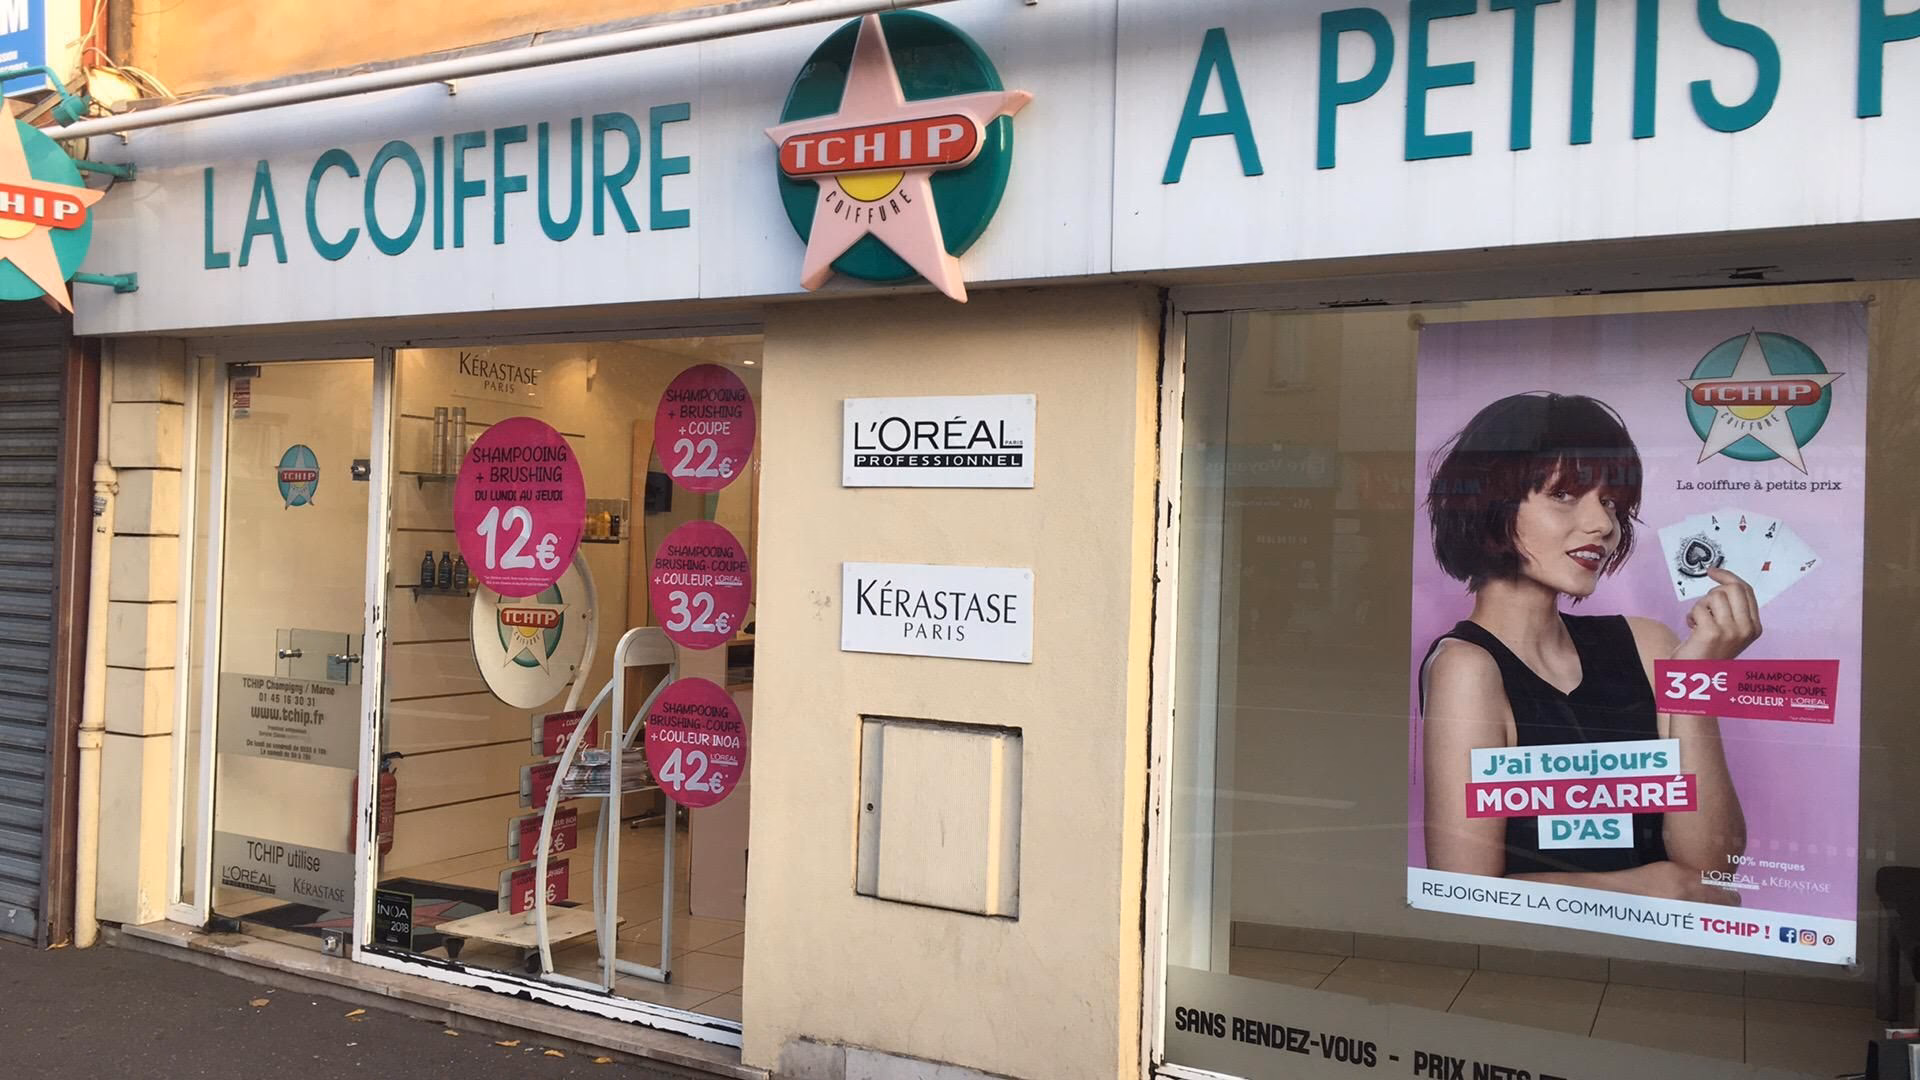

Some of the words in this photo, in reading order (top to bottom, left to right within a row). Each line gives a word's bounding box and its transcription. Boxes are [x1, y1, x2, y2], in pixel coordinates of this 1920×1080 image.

[1162, 27, 1263, 184] A
[788, 123, 964, 169] TCHIP
[204, 160, 288, 269] LA
[305, 102, 690, 262] COIFFURE
[825, 188, 912, 224] COIFFURE
[460, 351, 538, 386] KÉRASTASE
[484, 380, 515, 393] PARIS
[666, 389, 745, 402] SHAMPOOING
[1699, 384, 1812, 401] TCHIP
[680, 405, 742, 418] BRUSHING
[1721, 412, 1780, 430] COIFFURE
[854, 416, 1023, 452] L'ORÉAL
[472, 445, 567, 463] SHAMPOOING
[856, 455, 1021, 467] PROFESSIONNEL
[283, 472, 316, 481] TCHIP
[489, 466, 563, 483] BRUSHING
[1676, 480, 1694, 490] La
[1697, 480, 1750, 490] coiffure
[1754, 480, 1763, 490] à
[1766, 480, 1807, 492] petits
[1811, 480, 1842, 492] prix
[475, 490, 488, 501] DU
[490, 490, 517, 501] LUNDI
[519, 490, 533, 501] AU
[535, 490, 563, 501] JEUDI
[667, 545, 734, 558] SHAMPOOING
[857, 579, 1017, 624] KÉRASTASE
[503, 609, 557, 625] TCHIP
[904, 622, 965, 641] PARIS
[243, 677, 264, 689] TCHIP
[266, 679, 304, 695] Champigny
[311, 684, 335, 696] Marne
[1665, 671, 1728, 701] 32€
[1745, 671, 1821, 684] SHAMPOOING
[259, 692, 267, 702] 01
[270, 693, 280, 703] 45
[284, 695, 291, 705] 16
[294, 696, 304, 706] 30
[307, 697, 316, 707] 31
[250, 706, 324, 727] www.tchip.fr
[663, 702, 729, 719] SHAMPOOING
[712, 735, 740, 749] INOA
[1541, 749, 1668, 776] toujours
[1476, 786, 1555, 812] MON
[1565, 776, 1688, 809] CARRÉ
[247, 841, 284, 865] TCHIP
[287, 850, 321, 872] utilise
[1727, 854, 1756, 867] 100%
[1759, 860, 1806, 872] marques
[222, 866, 277, 888] L'ORÉAL
[293, 877, 345, 903] KÉRASTASE
[1422, 882, 1522, 907] REJOIGNEZ
[1527, 895, 1551, 910] LA
[1556, 898, 1695, 930] COMMUNAUTÉ
[1700, 917, 1760, 937] TCHIP
[1764, 925, 1771, 940] !
[1175, 1006, 1226, 1039] SANS
[1232, 1016, 1377, 1068] RENDEZ-VOUS
[1414, 1050, 1465, 1080] PRIX
